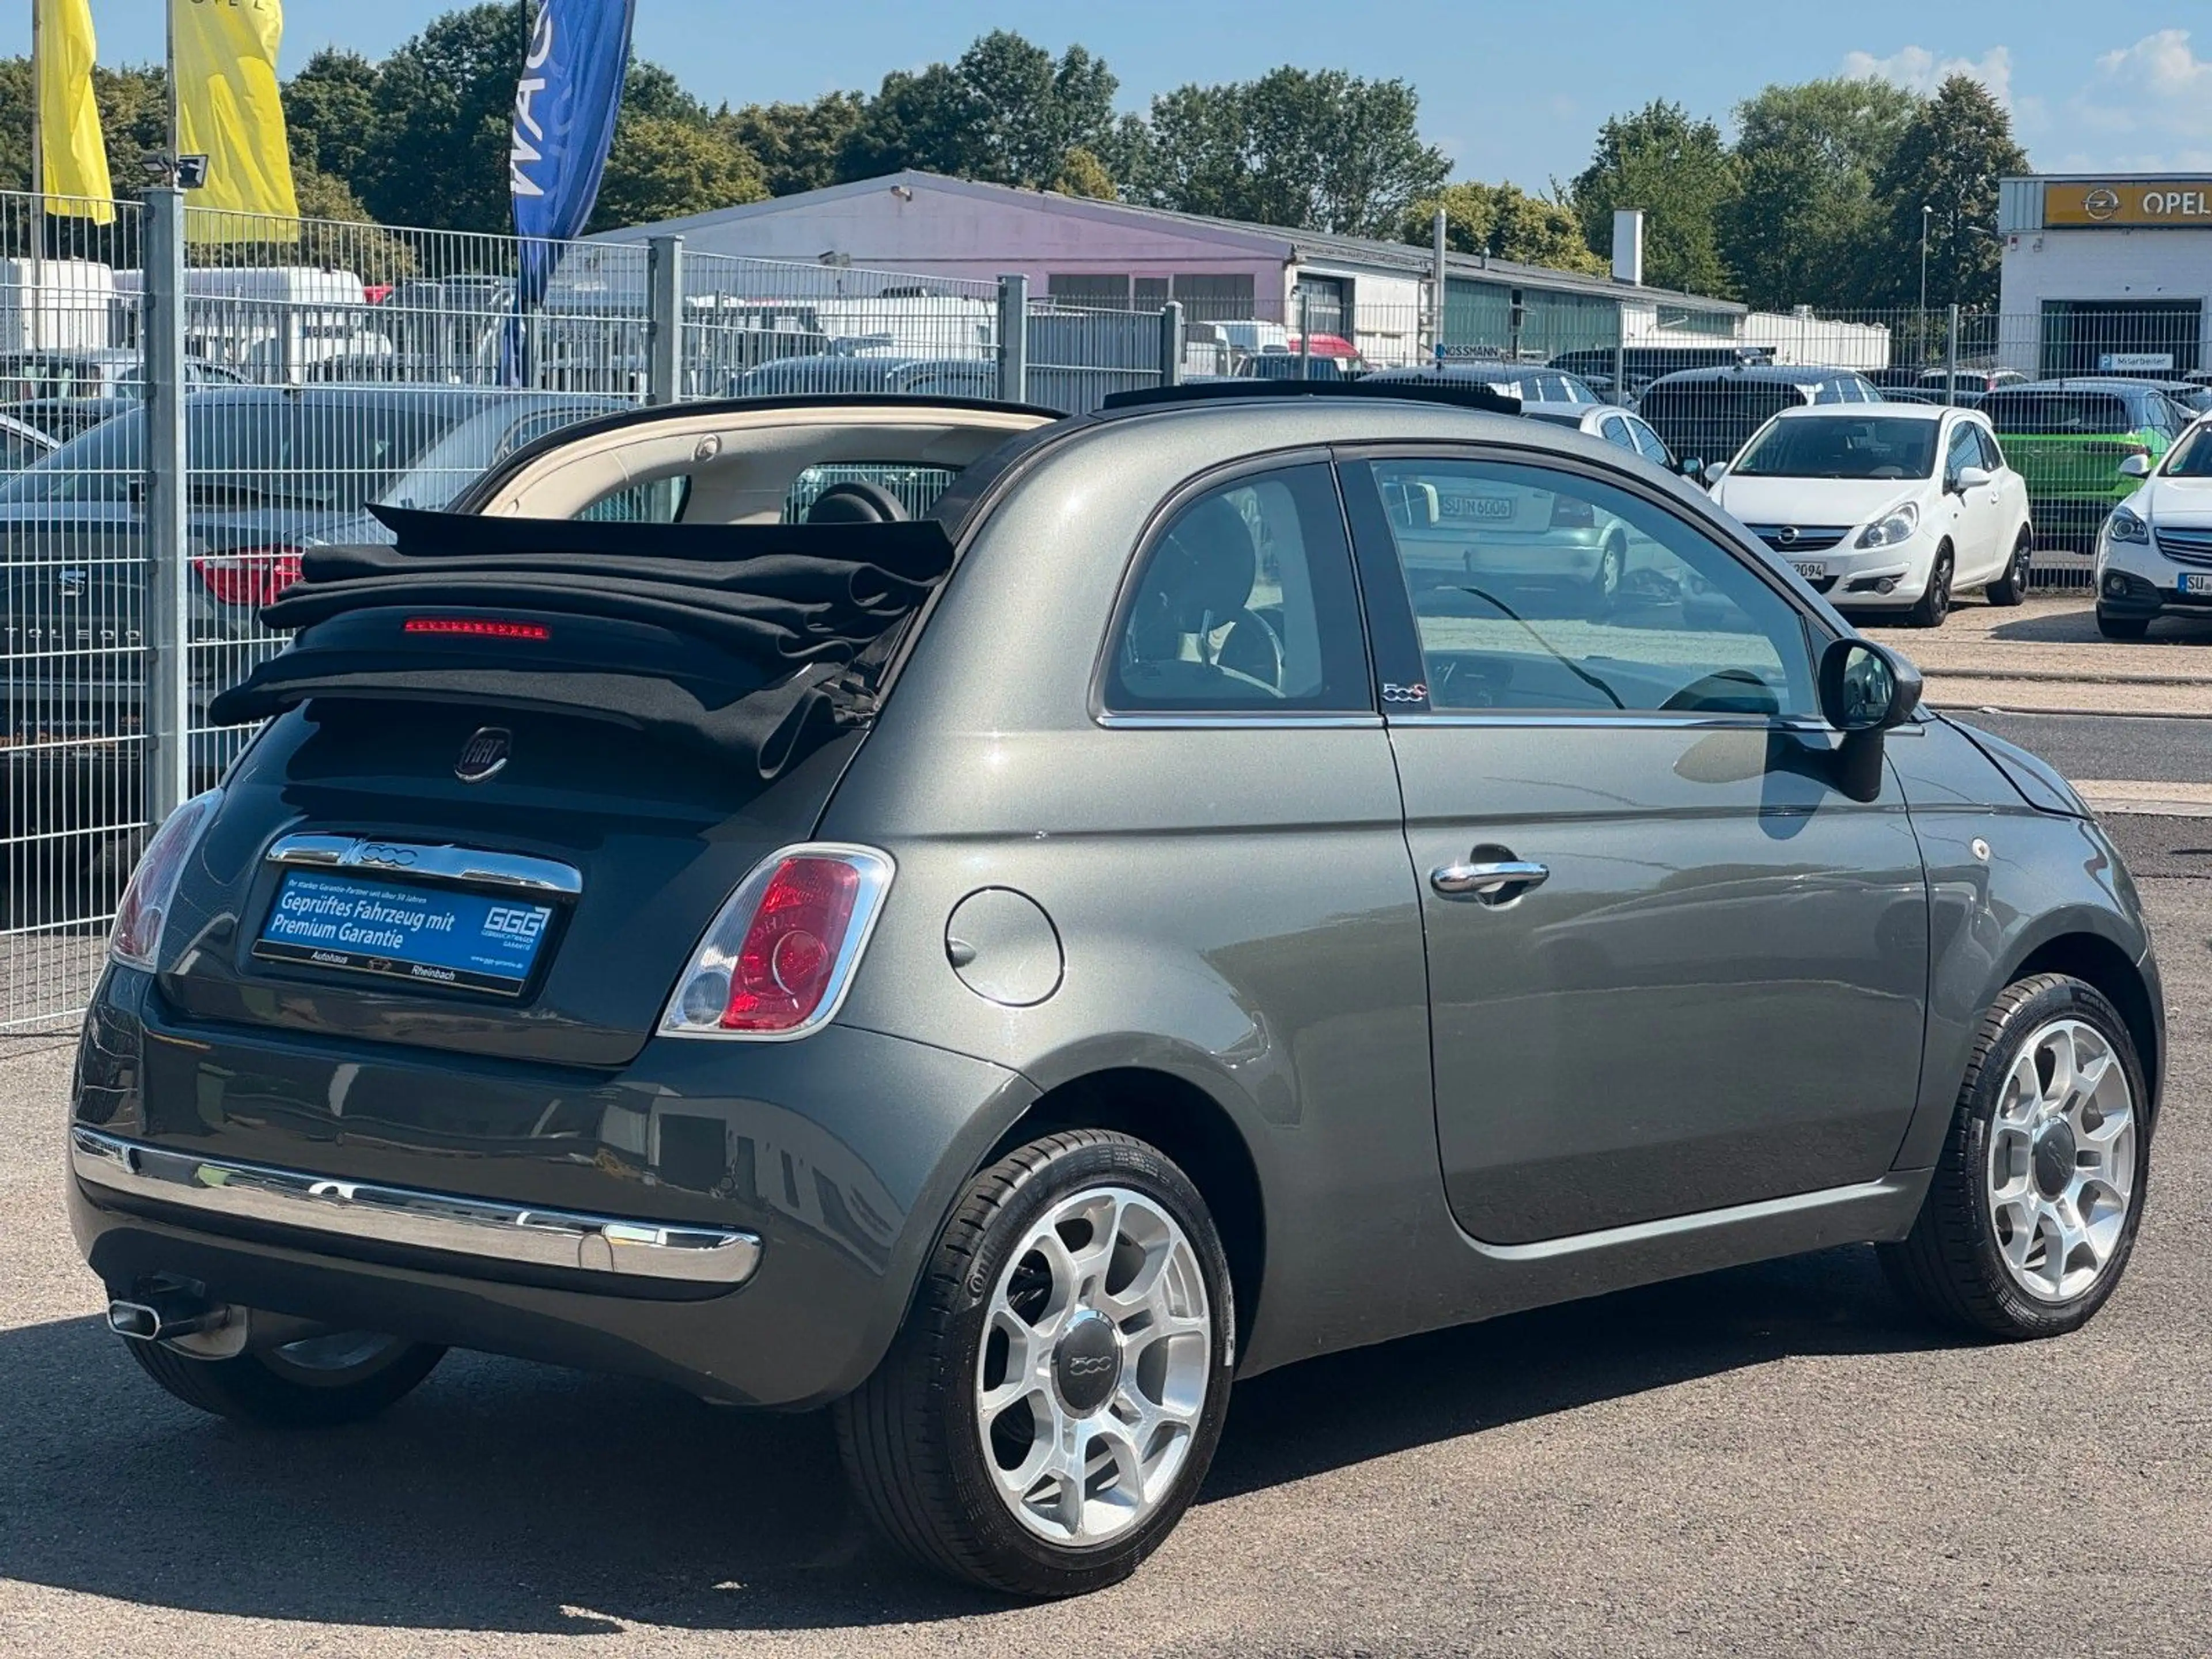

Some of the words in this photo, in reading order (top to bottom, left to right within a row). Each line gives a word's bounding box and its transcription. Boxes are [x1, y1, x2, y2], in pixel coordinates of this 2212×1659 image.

[2143, 192, 2211, 214] OPEL
[2188, 577, 2203, 590] SU
[464, 739, 505, 764] FIAT
[361, 843, 418, 866] 500
[281, 892, 353, 917] Geprüftes
[353, 900, 425, 932] Fahrzeug
[425, 912, 456, 932] mit
[271, 914, 336, 939] Premium
[338, 922, 404, 949] Garantie
[311, 950, 349, 964] Autohaus
[411, 965, 455, 981] Rheinbach
[1070, 1356, 1112, 1376] 500
